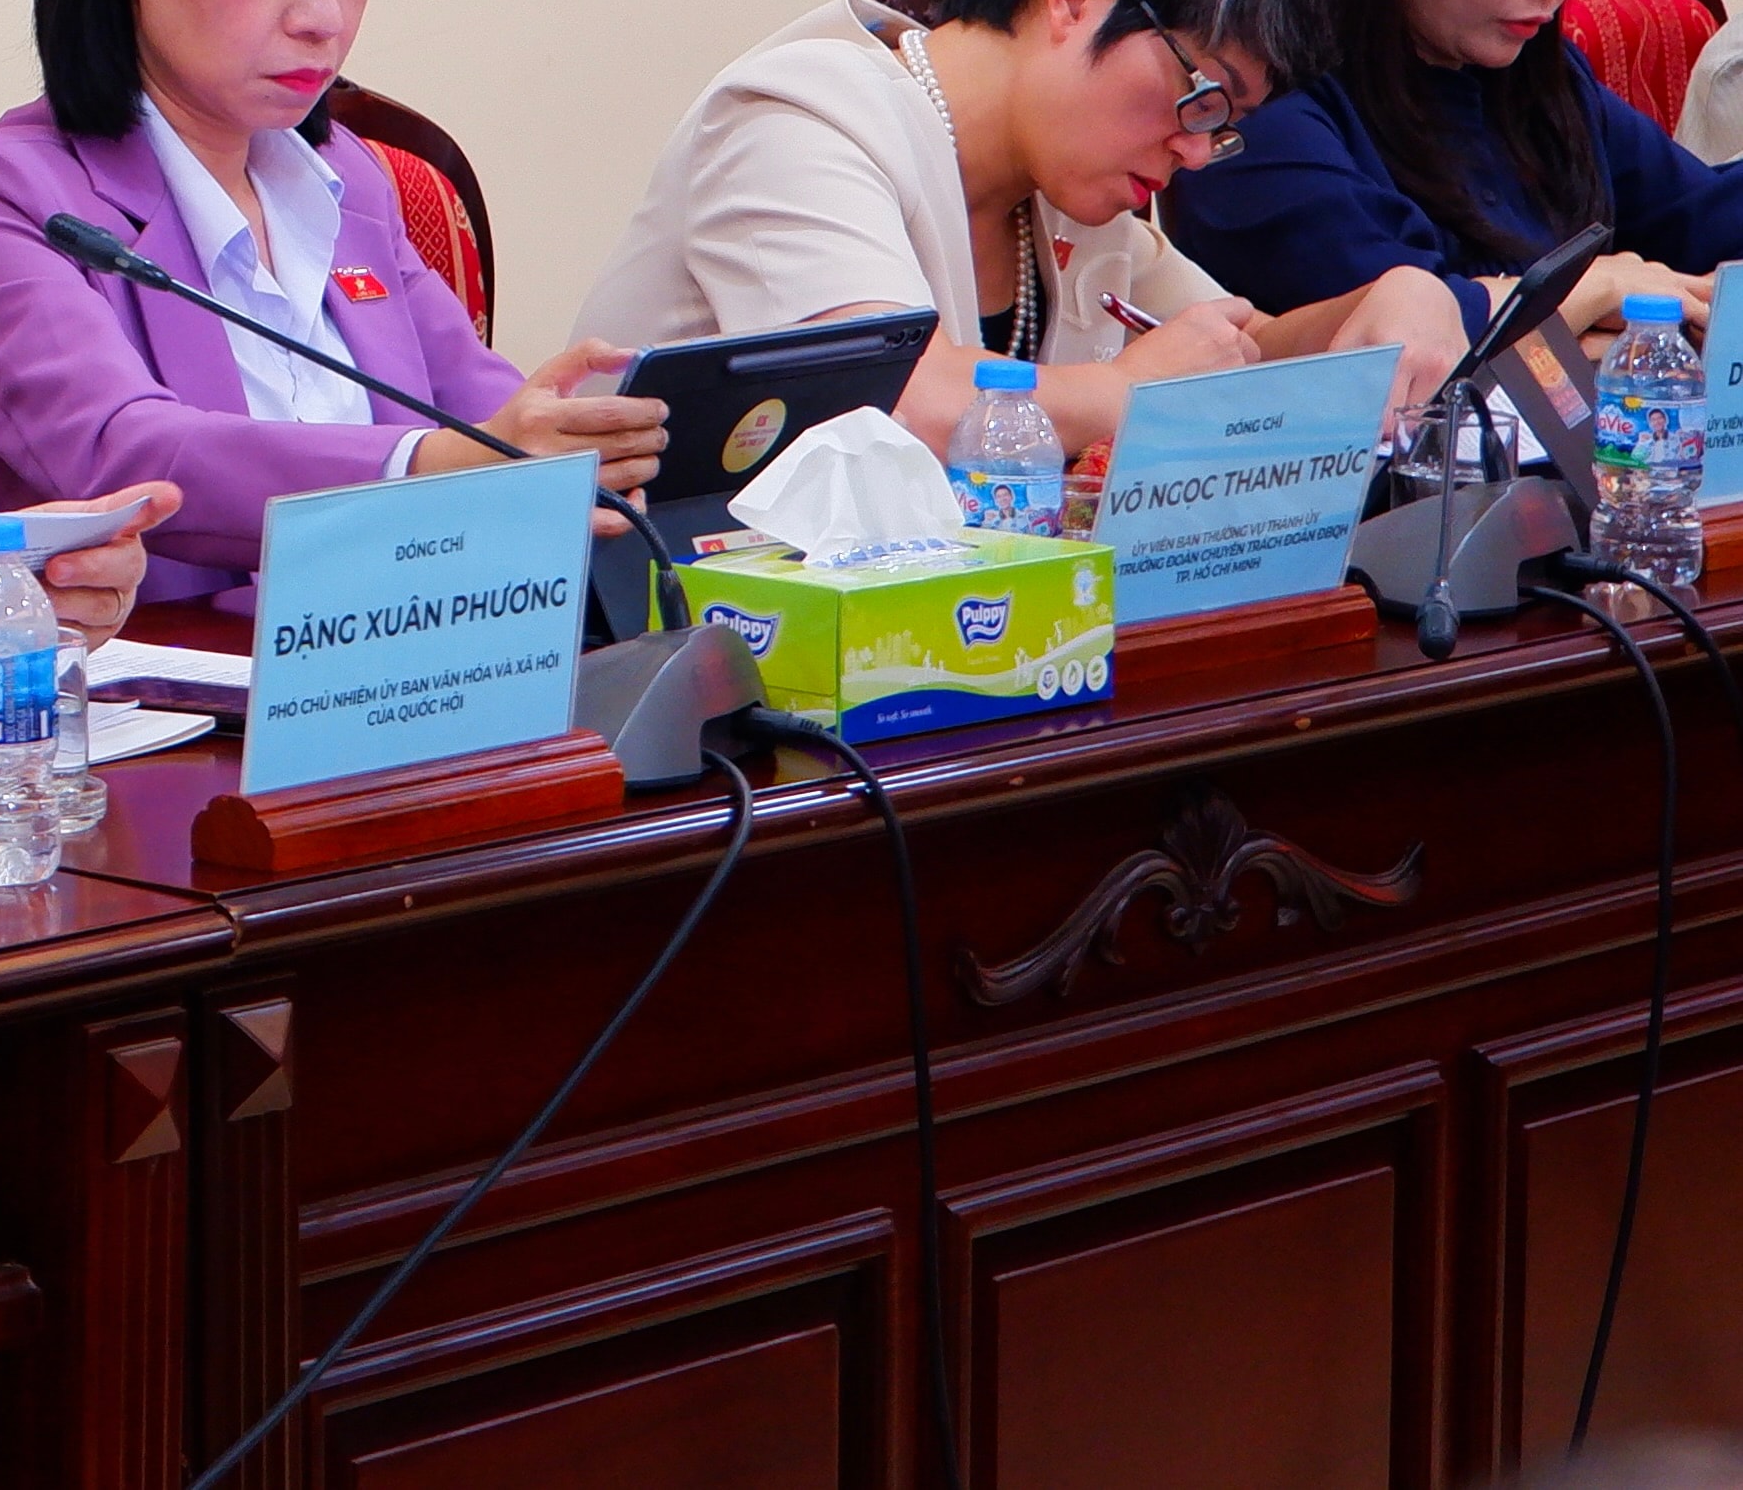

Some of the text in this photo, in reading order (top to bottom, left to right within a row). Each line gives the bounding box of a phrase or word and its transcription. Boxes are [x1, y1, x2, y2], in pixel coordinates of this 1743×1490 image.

[1225, 411, 1285, 437] ĐỒNG CHÍ
[1110, 445, 1369, 516] VÕ NGỌC THANH TRÚC
[395, 530, 465, 562] ĐỒNG CHÍ
[1176, 532, 1201, 549] BAN
[274, 577, 568, 660] ĐẶNG XUÂN PHƯƠNG
[961, 604, 1006, 627] Pulppy
[267, 697, 298, 721] PHÓ
[300, 689, 330, 714] CHỦ
[332, 684, 377, 708] NHIỆM
[380, 678, 399, 700] ỦY
[401, 678, 430, 696] BAN
[432, 669, 461, 690] VĂN
[495, 657, 512, 678] VÀ
[516, 653, 533, 674] XÃ
[536, 649, 559, 673] HỘI
[367, 690, 464, 726] CỦA QUỐC HỘI
